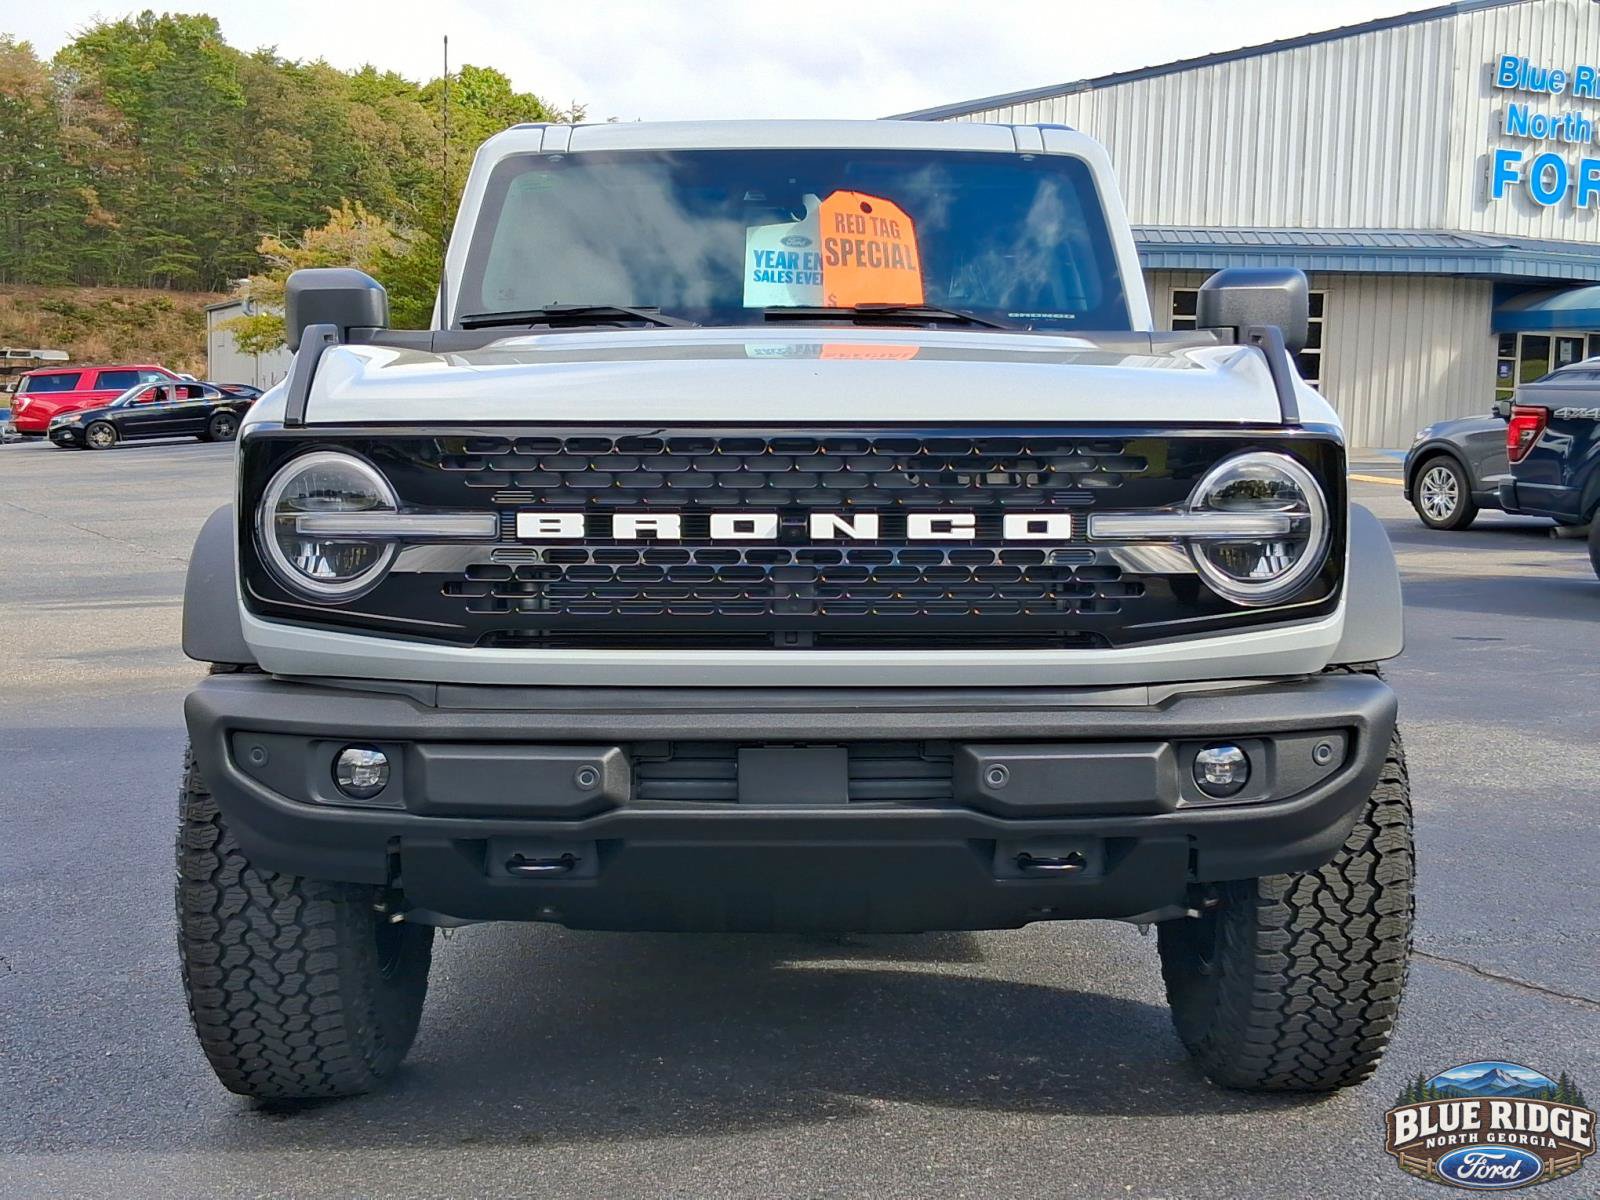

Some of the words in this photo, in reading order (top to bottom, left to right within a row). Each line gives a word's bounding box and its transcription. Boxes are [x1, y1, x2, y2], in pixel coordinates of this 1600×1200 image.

[1496, 54, 1566, 94] Blue
[1505, 102, 1592, 144] North
[1492, 148, 1600, 209] FOR
[834, 212, 866, 235] RED
[869, 215, 902, 240] TAG
[753, 249, 799, 270] YEAR
[824, 237, 916, 271] SPECIAL
[753, 269, 793, 284] SALES
[796, 271, 823, 286] EVE
[516, 512, 1072, 540] BRONCO
